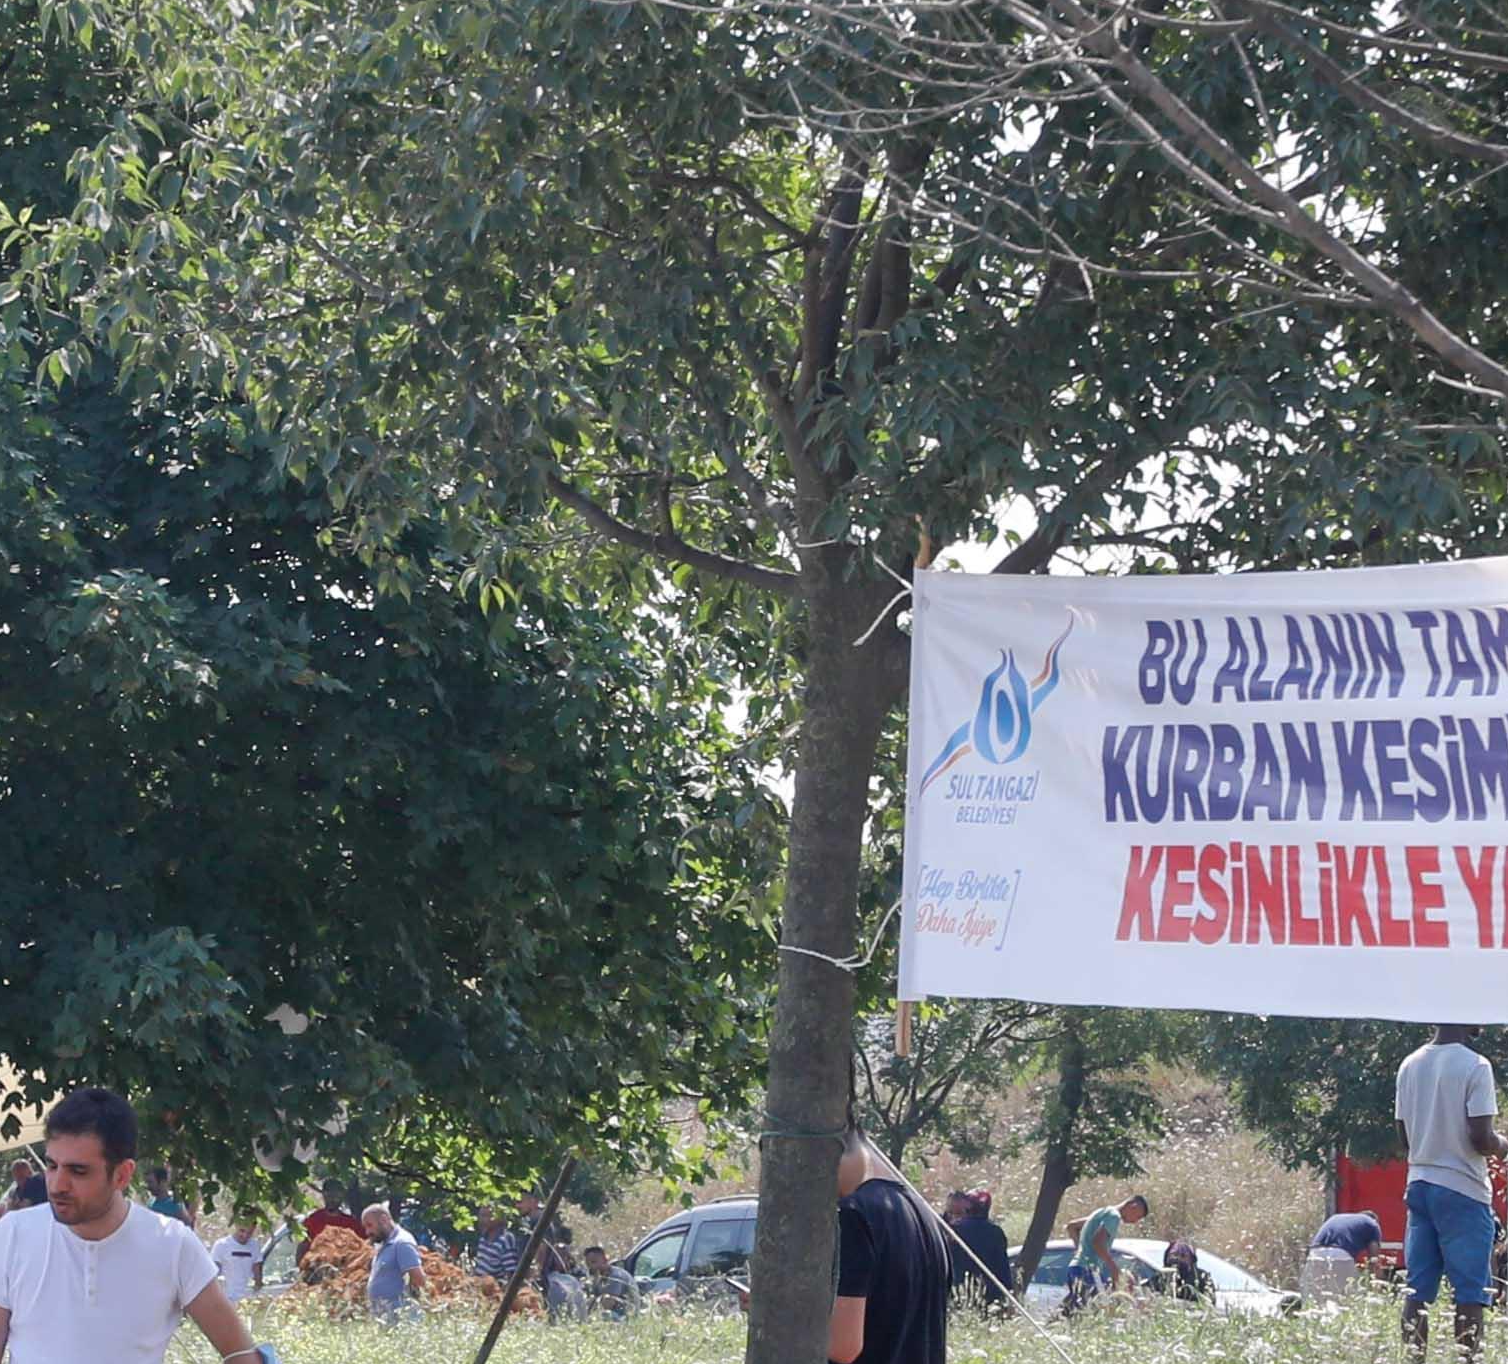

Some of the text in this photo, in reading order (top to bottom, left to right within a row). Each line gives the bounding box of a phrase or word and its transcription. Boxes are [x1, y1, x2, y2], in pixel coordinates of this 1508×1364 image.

[1138, 618, 1207, 705] BU
[1212, 611, 1405, 703] ALANIN
[945, 771, 1039, 801] SULTANGAZİ
[1102, 719, 1327, 823] KURBAN
